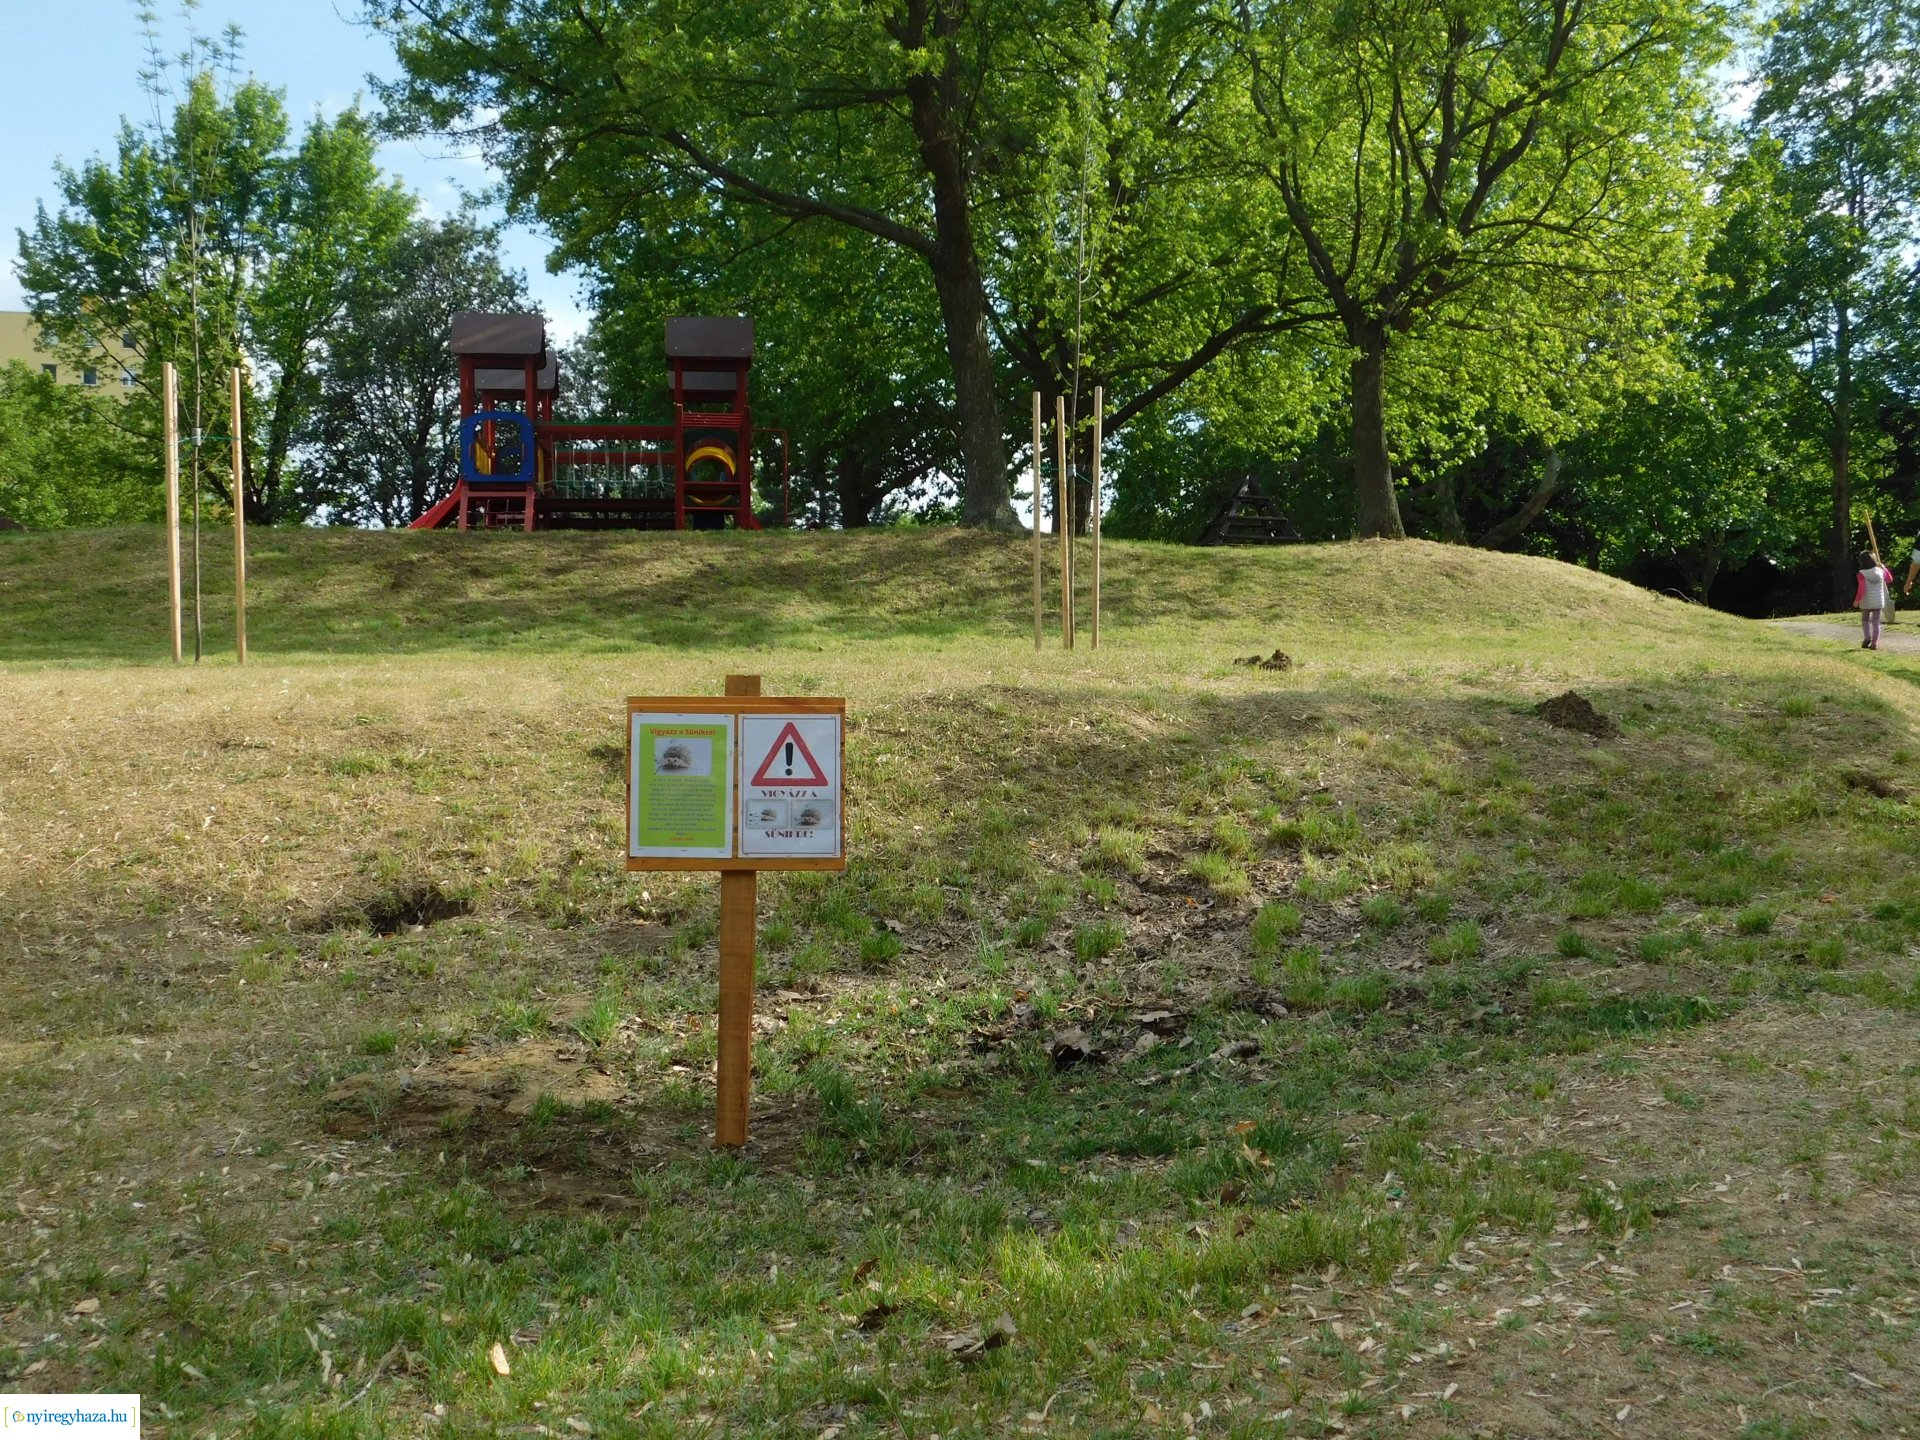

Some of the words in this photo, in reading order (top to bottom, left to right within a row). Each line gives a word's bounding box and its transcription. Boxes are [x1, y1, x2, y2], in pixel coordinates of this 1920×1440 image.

[649, 728, 677, 736] Vigyázz
[761, 789, 807, 798] VIGYÁZZ
[809, 790, 818, 798] A
